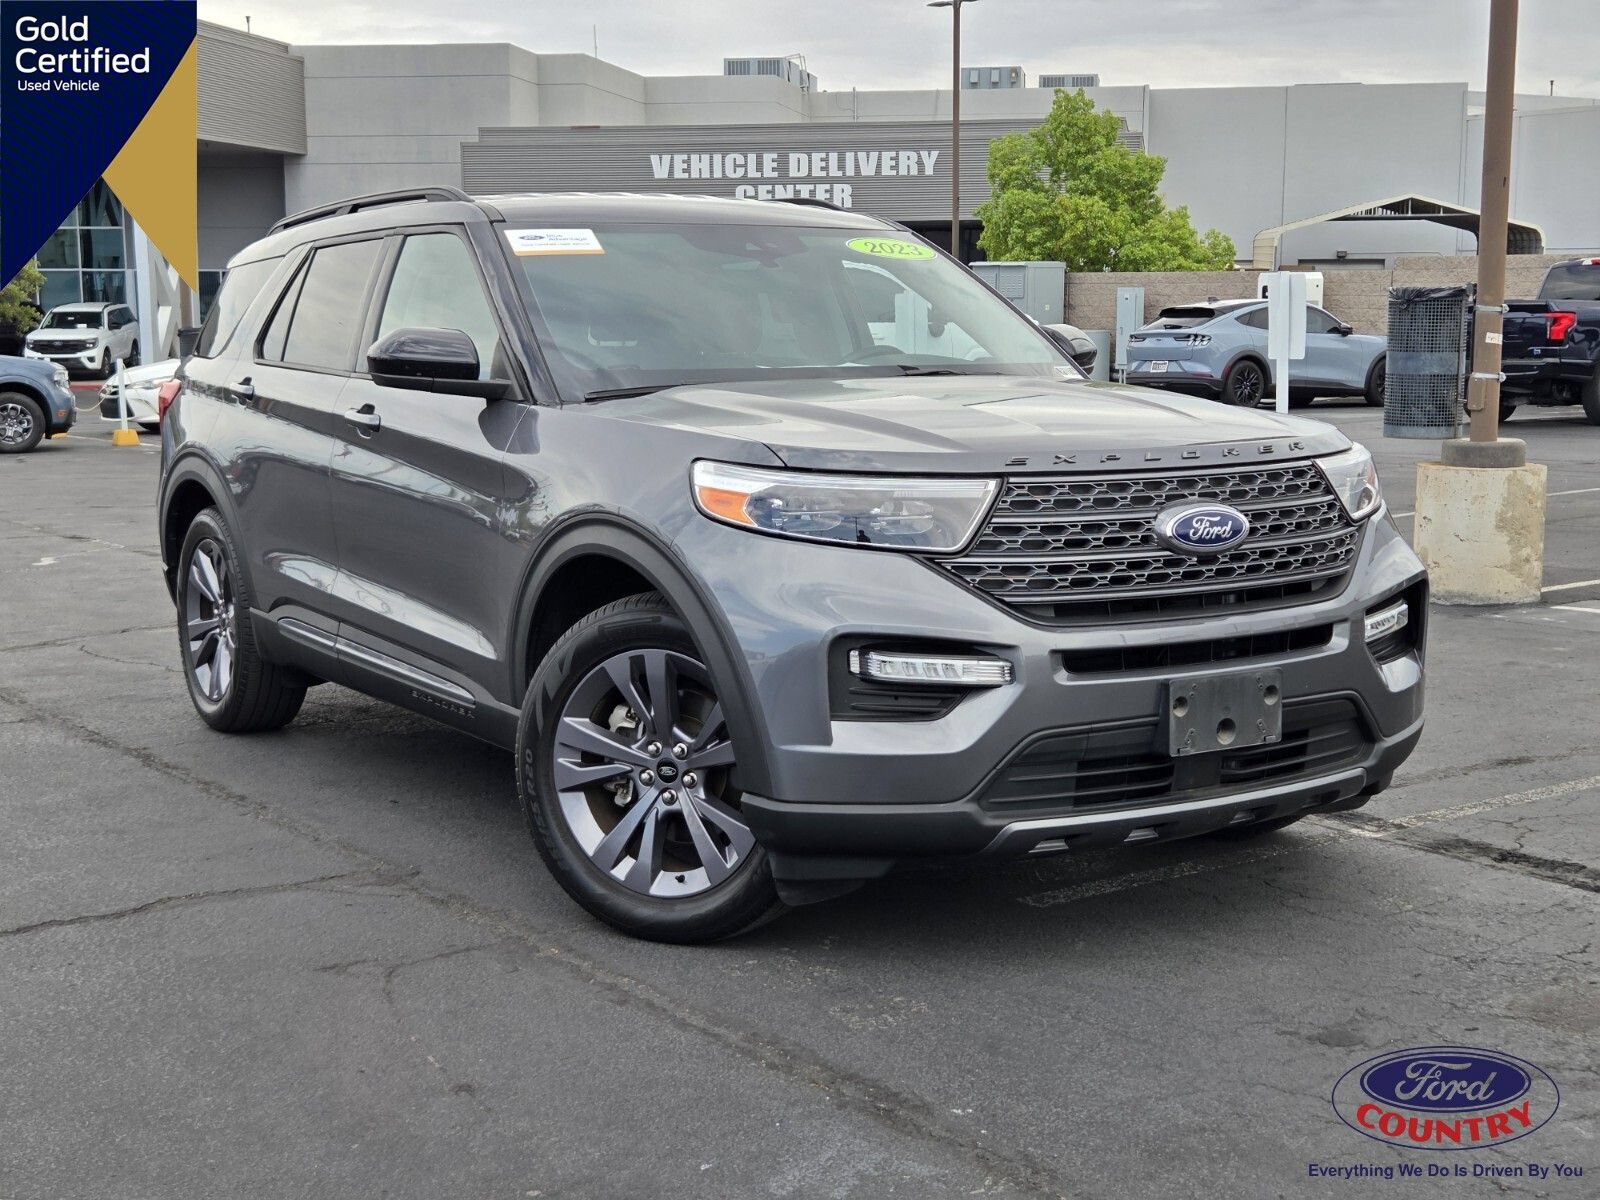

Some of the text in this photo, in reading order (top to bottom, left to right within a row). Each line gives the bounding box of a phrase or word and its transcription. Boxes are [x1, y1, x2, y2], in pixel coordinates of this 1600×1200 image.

[650, 151, 939, 179] VEHICLE DELIVERY
[735, 184, 853, 208] CENTER
[864, 241, 923, 256] 2023
[1005, 440, 1306, 466] EXPLORER
[1189, 516, 1233, 540] Ford
